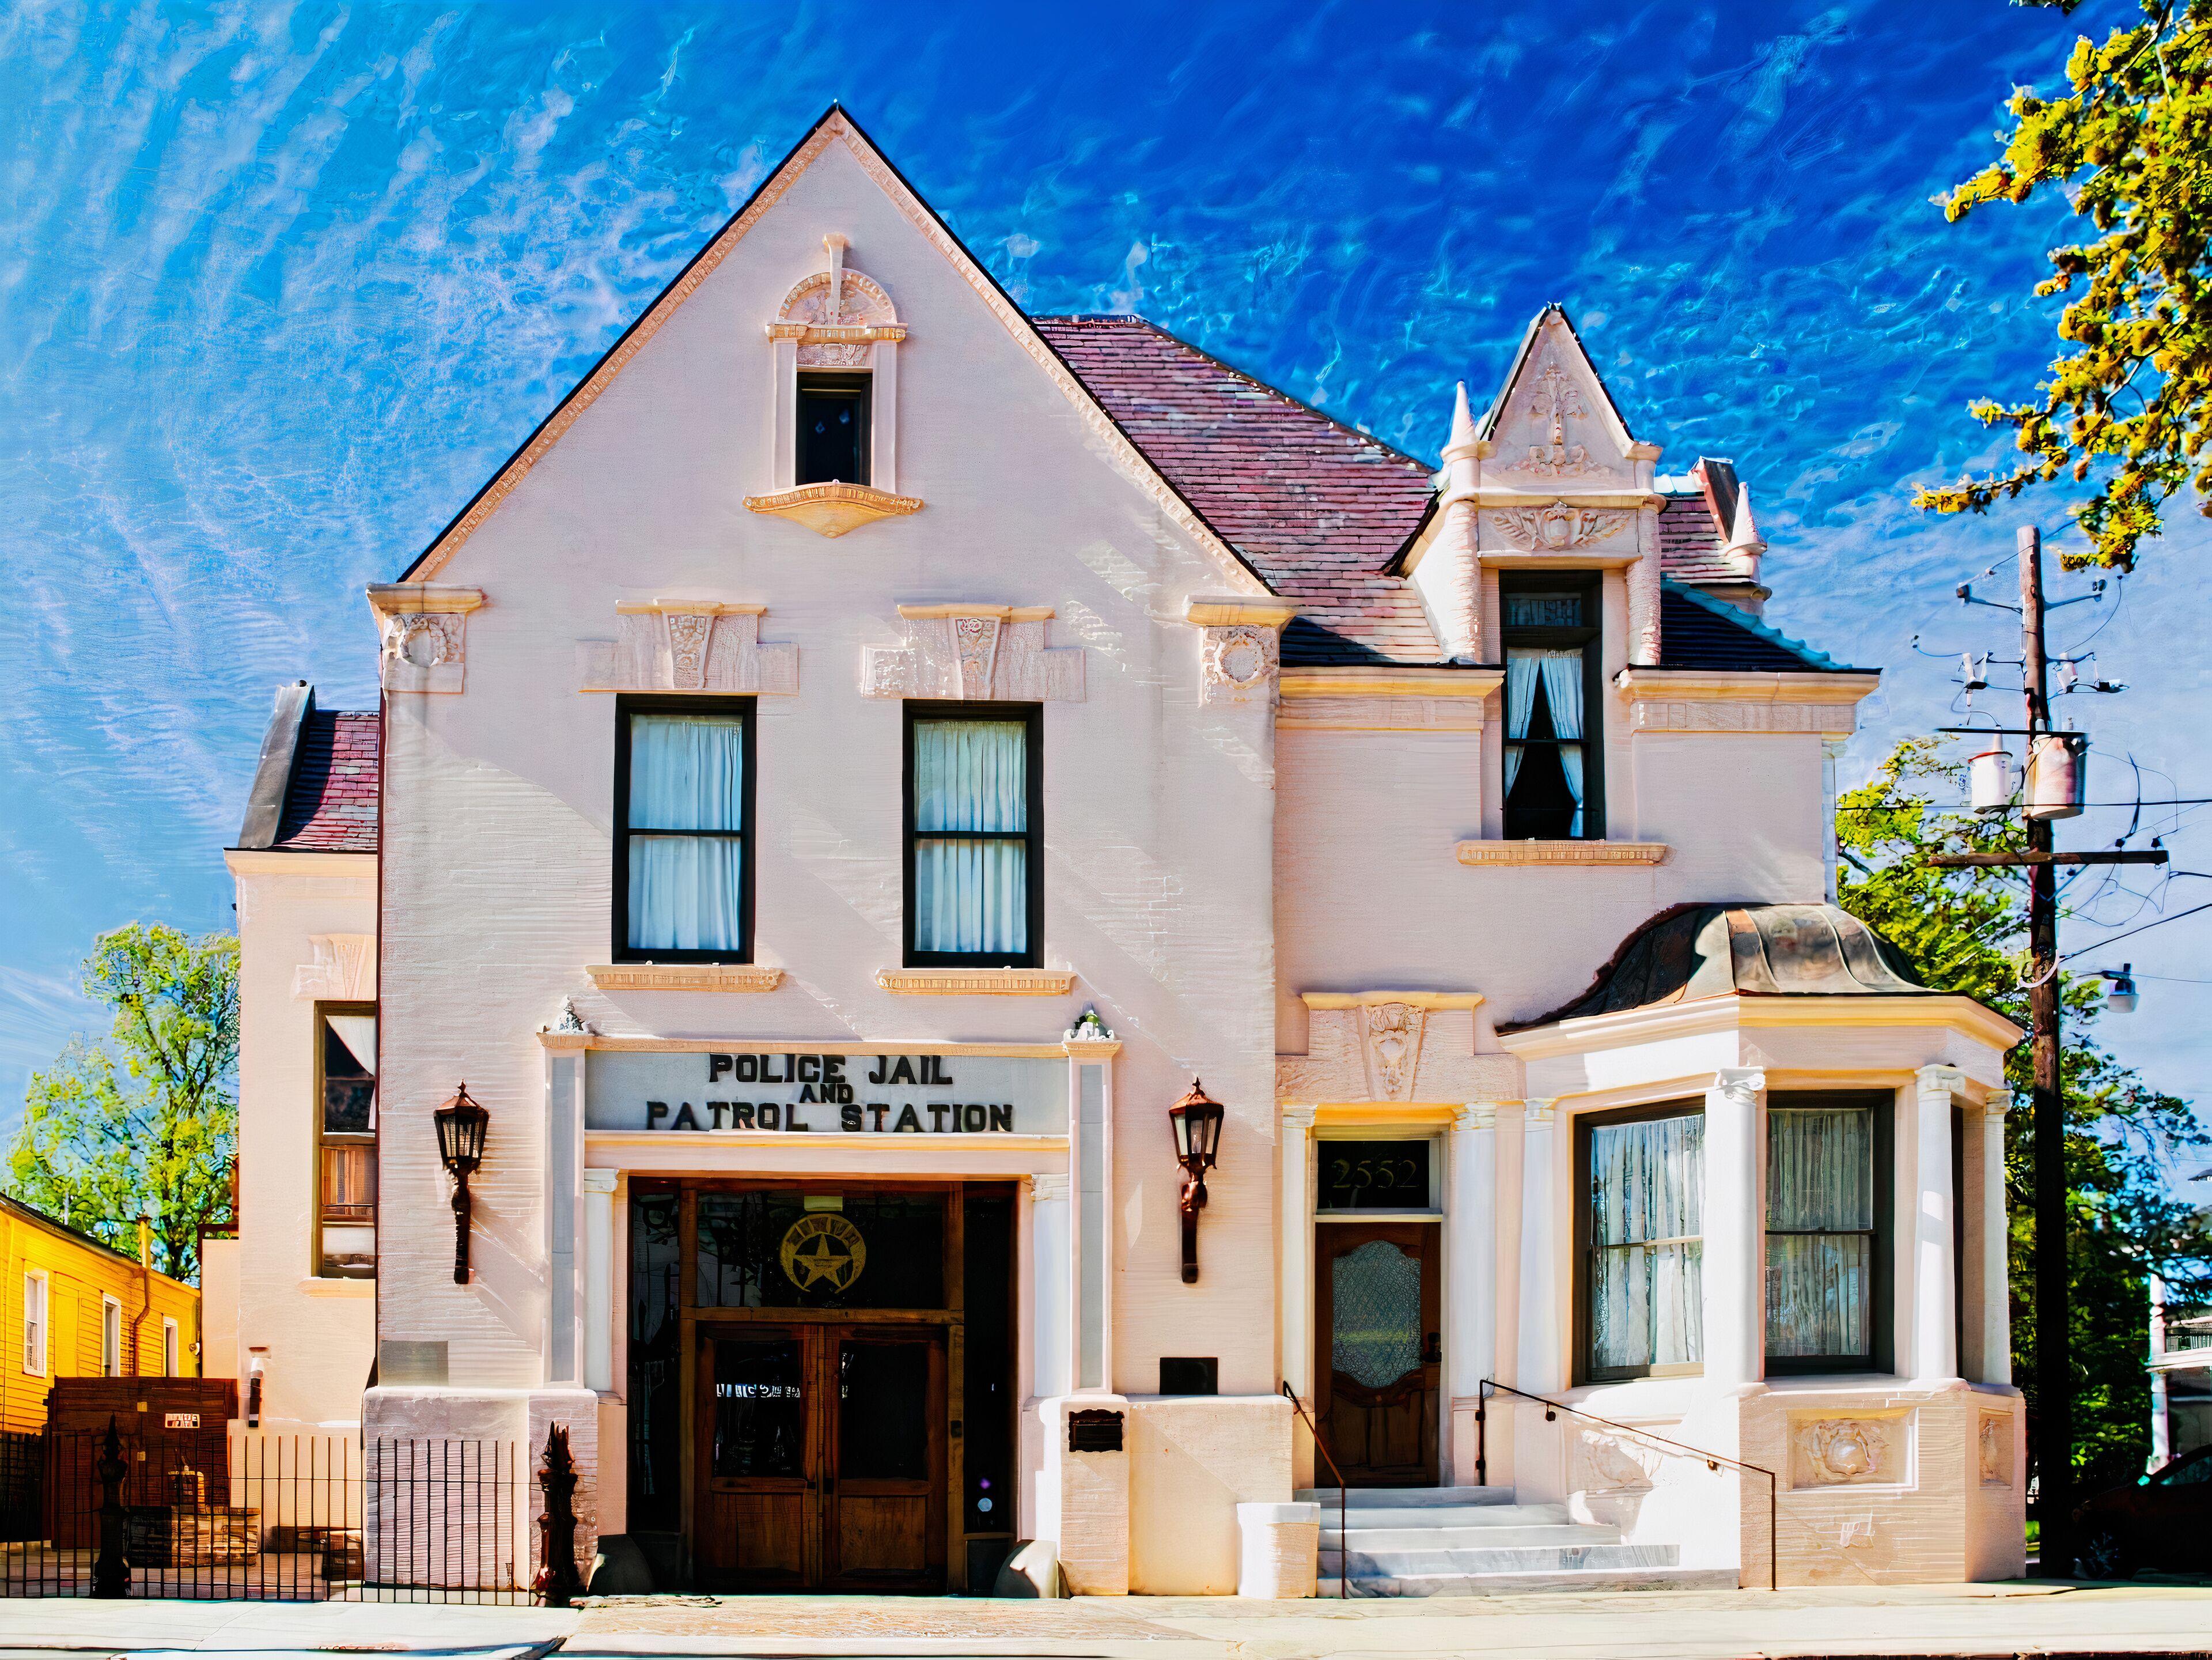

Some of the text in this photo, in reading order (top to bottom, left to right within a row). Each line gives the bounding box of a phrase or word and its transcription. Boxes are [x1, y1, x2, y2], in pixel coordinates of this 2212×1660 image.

[709, 1054, 953, 1084] POLICE JAIL
[800, 1084, 854, 1103] AND
[646, 1101, 1013, 1133] PATROL STATION
[1331, 1158, 1420, 1189] 2552
